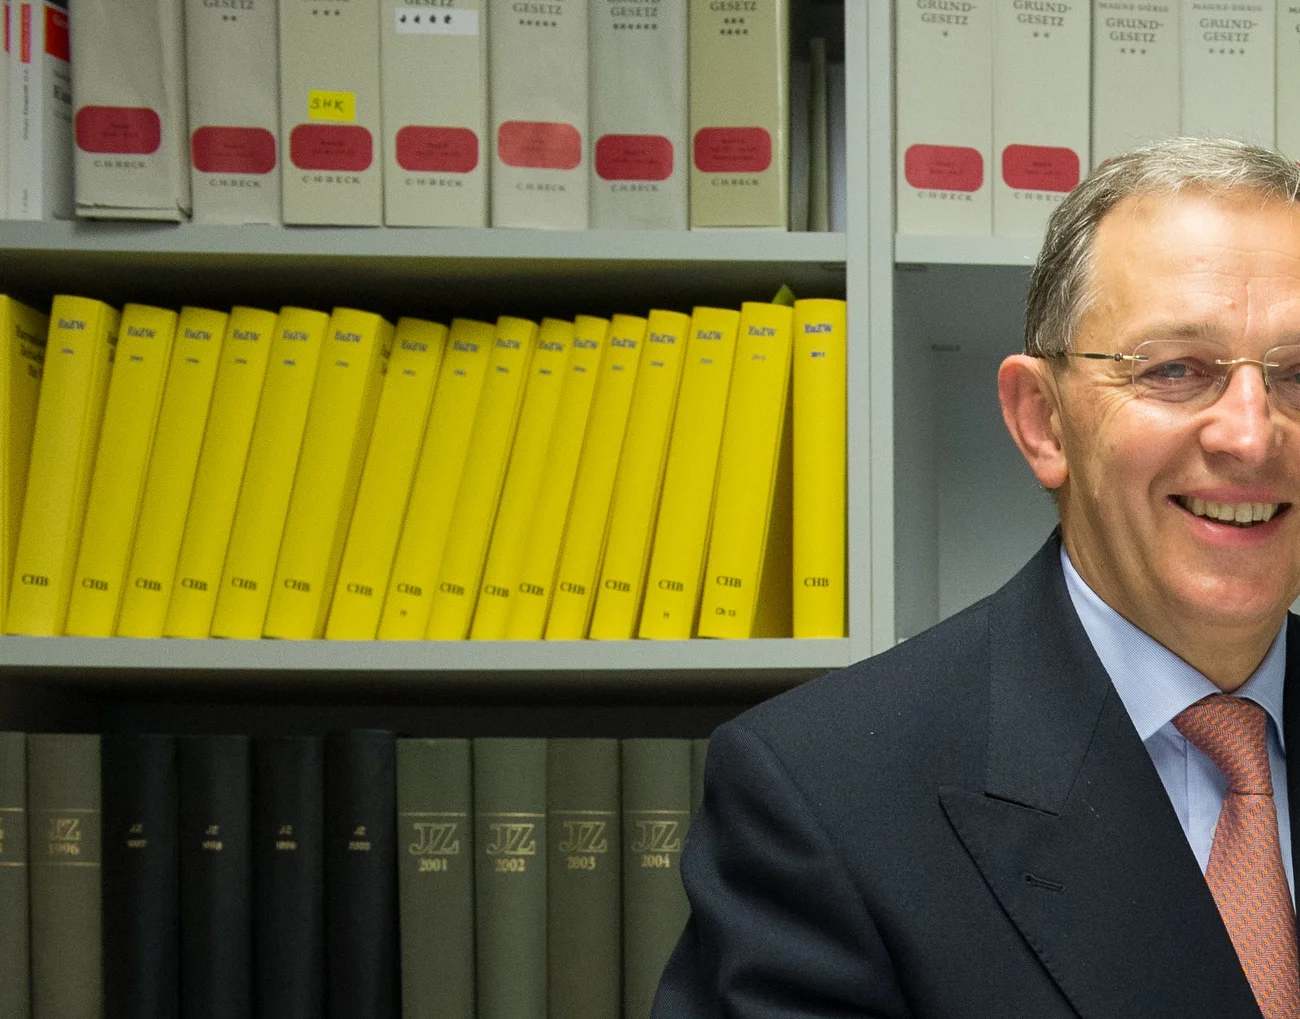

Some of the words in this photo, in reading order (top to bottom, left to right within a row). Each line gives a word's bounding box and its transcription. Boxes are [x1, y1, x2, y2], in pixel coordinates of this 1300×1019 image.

[512, 2, 562, 16] GESETZ
[610, 6, 658, 17] GESETZ
[709, 1, 756, 12] GESETZ
[921, 13, 968, 25] GESETZ
[1017, 13, 1064, 27] GESETZ
[1105, 17, 1164, 29] GRUND-
[1199, 18, 1257, 29] GRUND-
[1110, 30, 1156, 42] GESETZ
[1203, 31, 1249, 43] GESETZ
[309, 97, 345, 112] SHK
[696, 330, 723, 341] EuZW
[748, 326, 776, 337] EuZW
[804, 324, 832, 334] EuZW
[650, 332, 676, 344] EuZW
[21, 574, 49, 587] CHB
[82, 577, 109, 591] CHB
[135, 577, 162, 592] CHB
[181, 577, 208, 592] CHB
[231, 577, 258, 591] CHB
[284, 578, 311, 593] CHB
[605, 579, 631, 594] CHB
[658, 578, 684, 593] CHB
[716, 575, 742, 588] CHB
[804, 577, 830, 588] CHB
[346, 582, 373, 597] CHB
[397, 582, 422, 597] CHB
[440, 582, 465, 596] CHB
[484, 583, 510, 598] CHB
[519, 582, 544, 596] CHB
[559, 581, 586, 596] CHB
[418, 859, 448, 872] 2001
[495, 859, 526, 872] 2002
[641, 854, 670, 868] 2004
